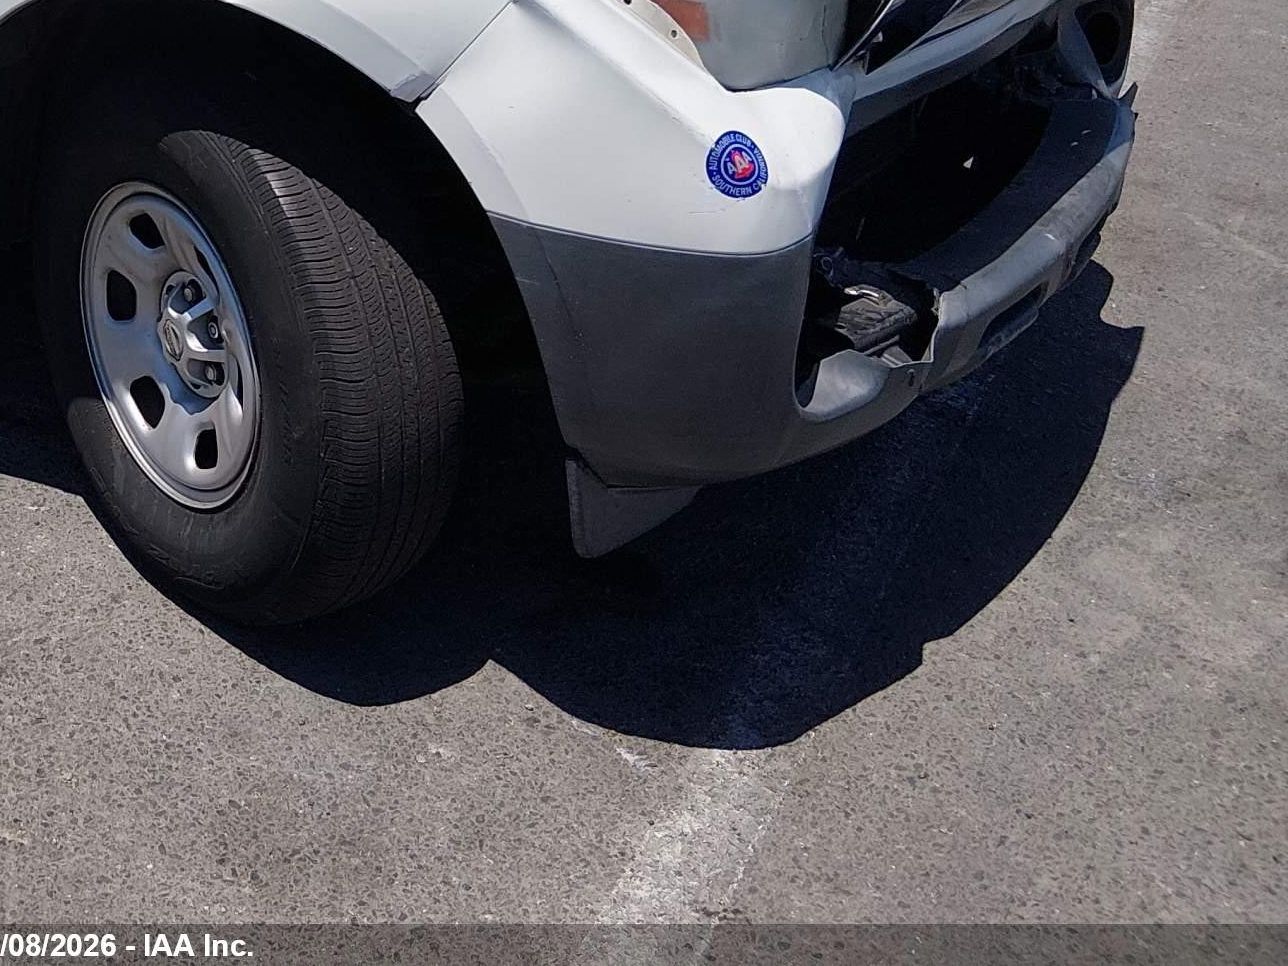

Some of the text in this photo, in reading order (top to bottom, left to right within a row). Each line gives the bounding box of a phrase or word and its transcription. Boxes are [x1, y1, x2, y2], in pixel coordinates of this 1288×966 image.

[708, 133, 752, 171] AUTOMOBILE CLUB
[712, 174, 752, 196] SOUTHERN
